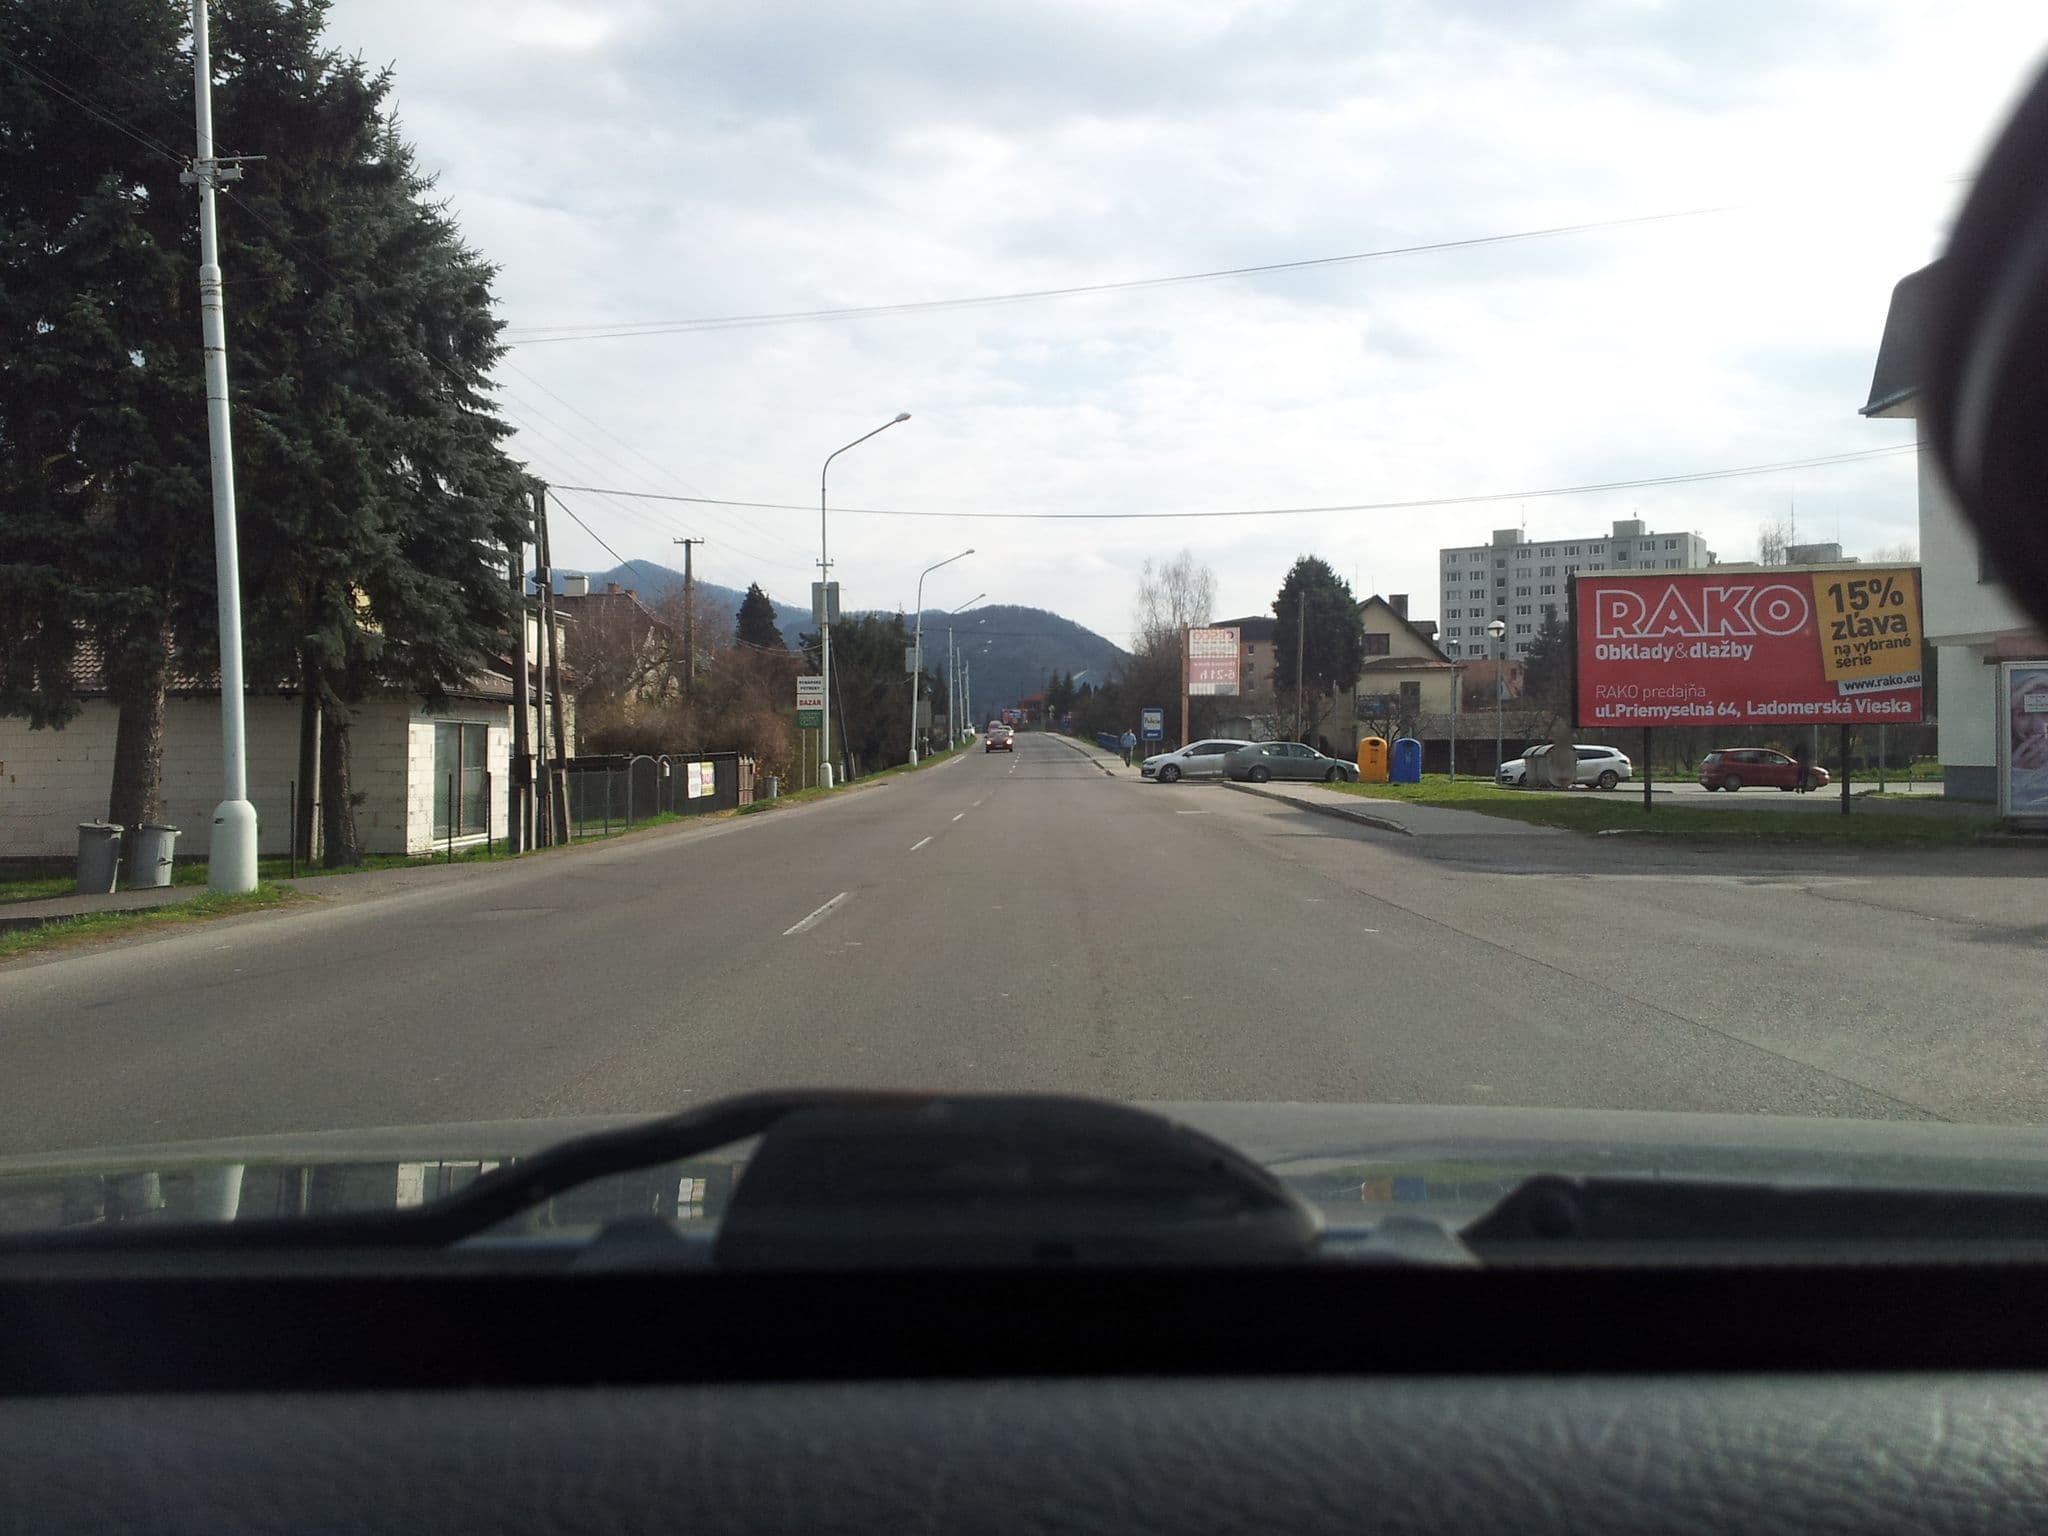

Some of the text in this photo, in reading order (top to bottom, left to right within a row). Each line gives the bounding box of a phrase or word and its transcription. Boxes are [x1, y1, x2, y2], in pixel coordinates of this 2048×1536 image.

[1828, 577, 1904, 613] 15%
[1596, 584, 1809, 638] RAKO
[1831, 611, 1908, 641] zľava
[1834, 634, 1912, 656] na vybrané
[1595, 683, 1706, 701] RAKO predajňa
[1844, 674, 1921, 691] www.rako.eu
[1717, 702, 1741, 718] 64,
[1747, 698, 1912, 716] Ladomerská Vieska
